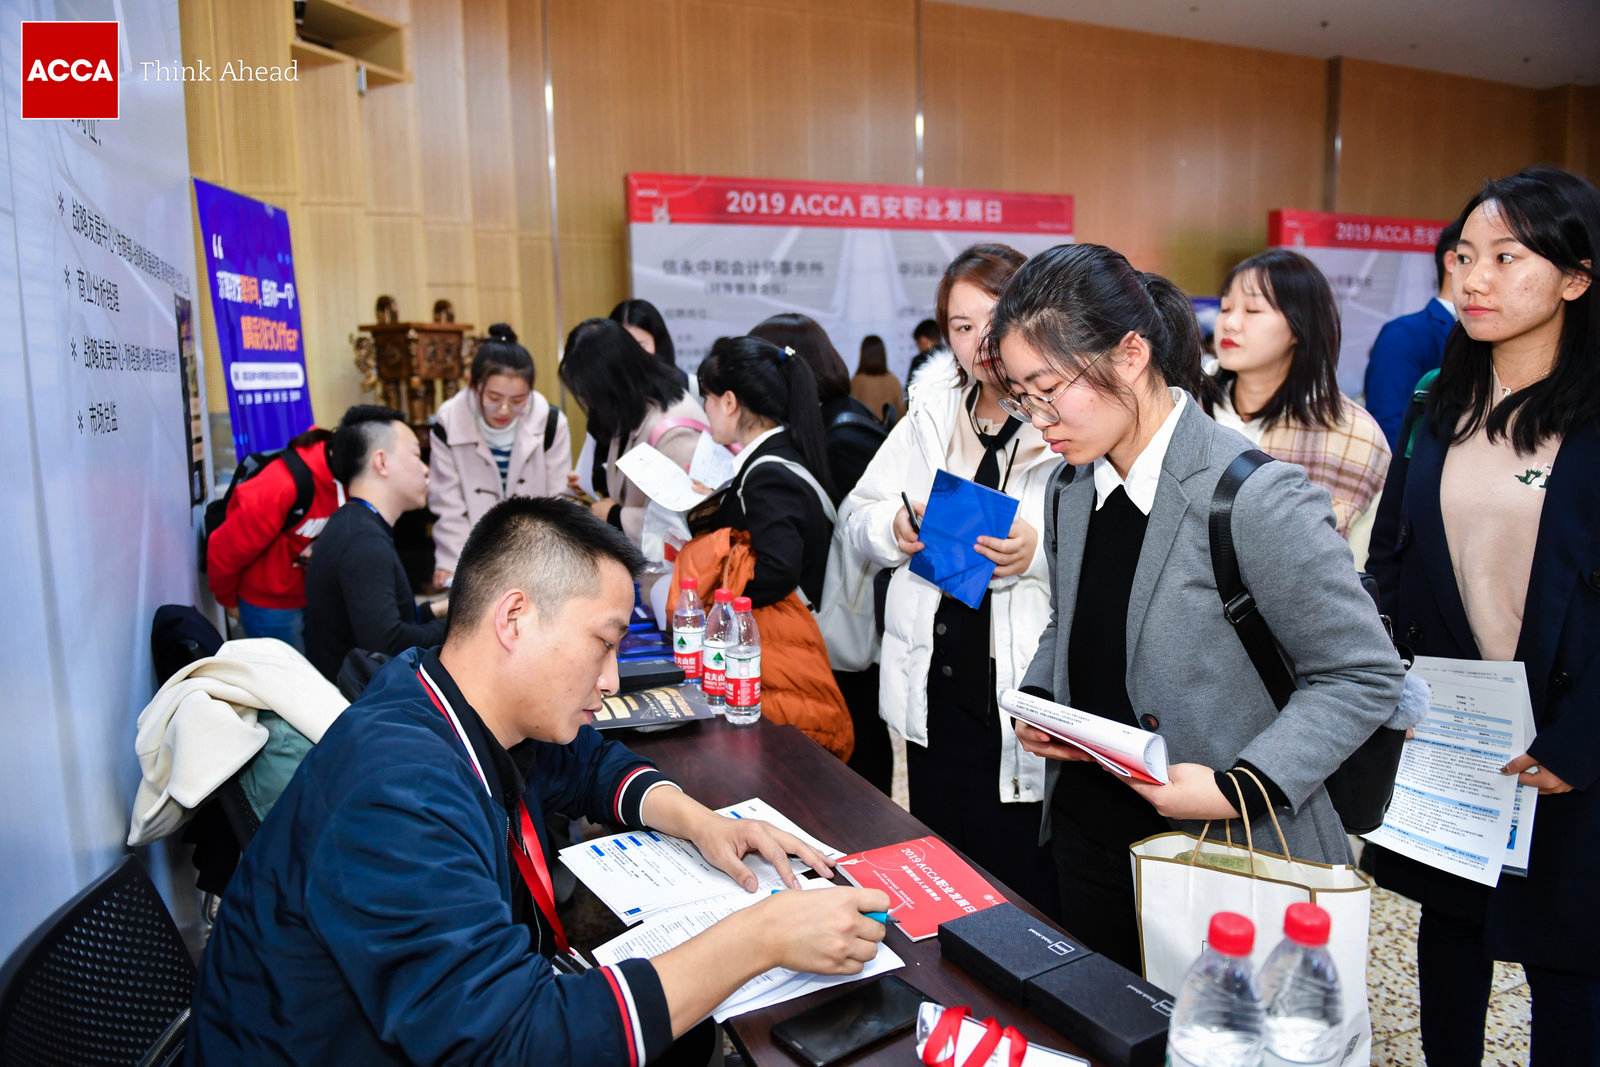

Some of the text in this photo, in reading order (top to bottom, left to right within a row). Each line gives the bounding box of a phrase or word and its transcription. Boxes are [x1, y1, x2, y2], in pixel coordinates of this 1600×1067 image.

[725, 190, 1003, 224] 2019 ACCA 西安职业发展日
[1336, 223, 1371, 241] 2019
[1372, 224, 1411, 243] ACCA
[900, 847, 922, 865] 2019
